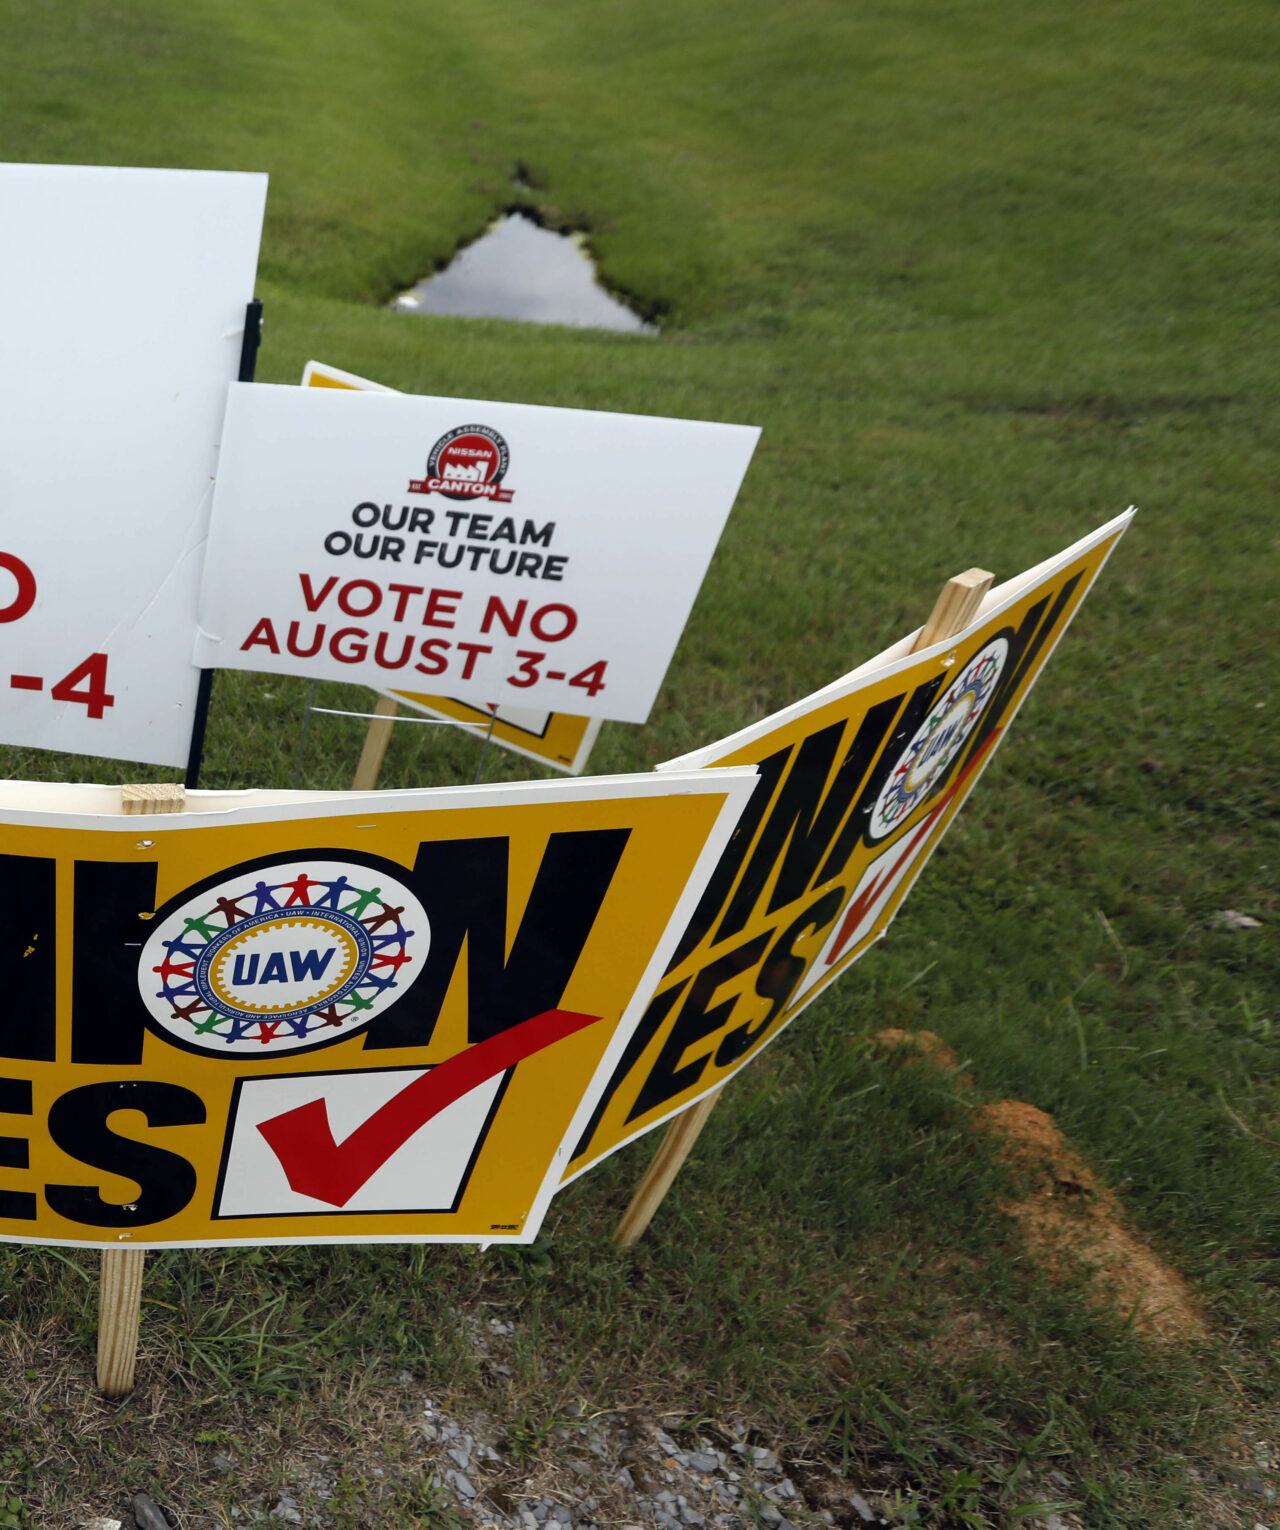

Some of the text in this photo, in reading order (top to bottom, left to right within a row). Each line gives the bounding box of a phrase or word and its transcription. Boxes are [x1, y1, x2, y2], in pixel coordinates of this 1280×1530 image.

[429, 432, 455, 467] VEHICLE
[447, 447, 493, 458] NISSAN
[427, 478, 497, 495] CANTON
[351, 501, 556, 548] OUR TEAM
[323, 530, 569, 582] OUR FUTURE
[298, 573, 578, 643] VOTE NO
[239, 617, 609, 697] AUGUST 3-4
[231, 927, 241, 935] OF
[244, 913, 279, 929] AMERICA
[311, 911, 360, 938] INTERNATIONAL
[232, 948, 336, 986] UAW
